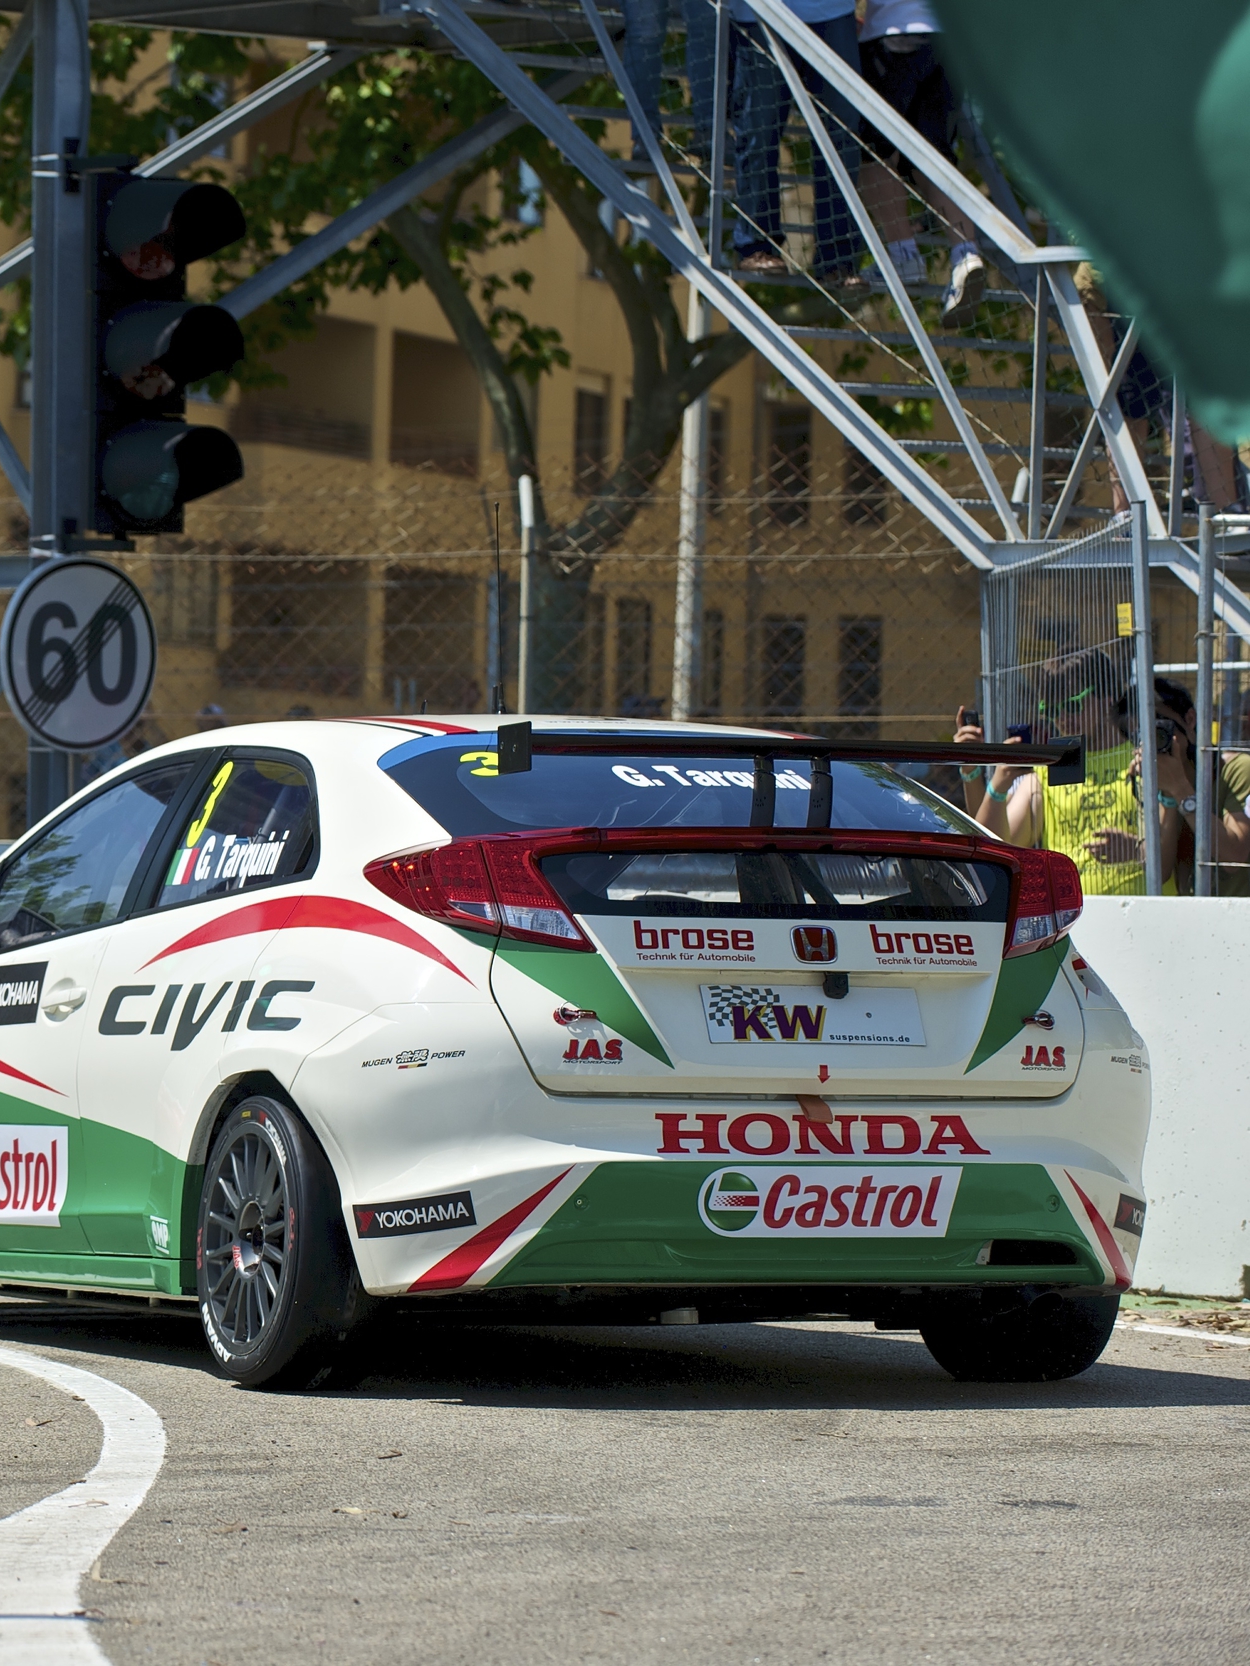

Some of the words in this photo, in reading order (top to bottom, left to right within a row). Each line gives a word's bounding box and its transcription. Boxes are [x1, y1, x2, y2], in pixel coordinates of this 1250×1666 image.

[26, 601, 138, 706] 60
[460, 751, 499, 777] 3
[186, 761, 234, 848] 3
[194, 835, 217, 882] G.
[214, 830, 290, 888] Tarquini
[633, 920, 755, 951] brose
[869, 924, 975, 955] brose
[636, 952, 677, 961] Technik
[679, 952, 695, 961] für
[697, 952, 756, 963] Automobile
[876, 956, 912, 965] Technik
[913, 956, 927, 965] für
[929, 956, 978, 967] Automobile
[98, 980, 316, 1052] CIVIC
[732, 1004, 827, 1042] KW
[562, 1038, 623, 1060] JAS
[829, 1033, 911, 1043] suspensions.de
[361, 1057, 393, 1068] MUGEN
[431, 1050, 466, 1060] POWER
[1020, 1045, 1066, 1067] JAS
[655, 1112, 992, 1155] HONDA
[375, 1201, 470, 1229] YOKOHAMA
[763, 1174, 943, 1229] Castrol
[151, 1220, 169, 1249] OMP
